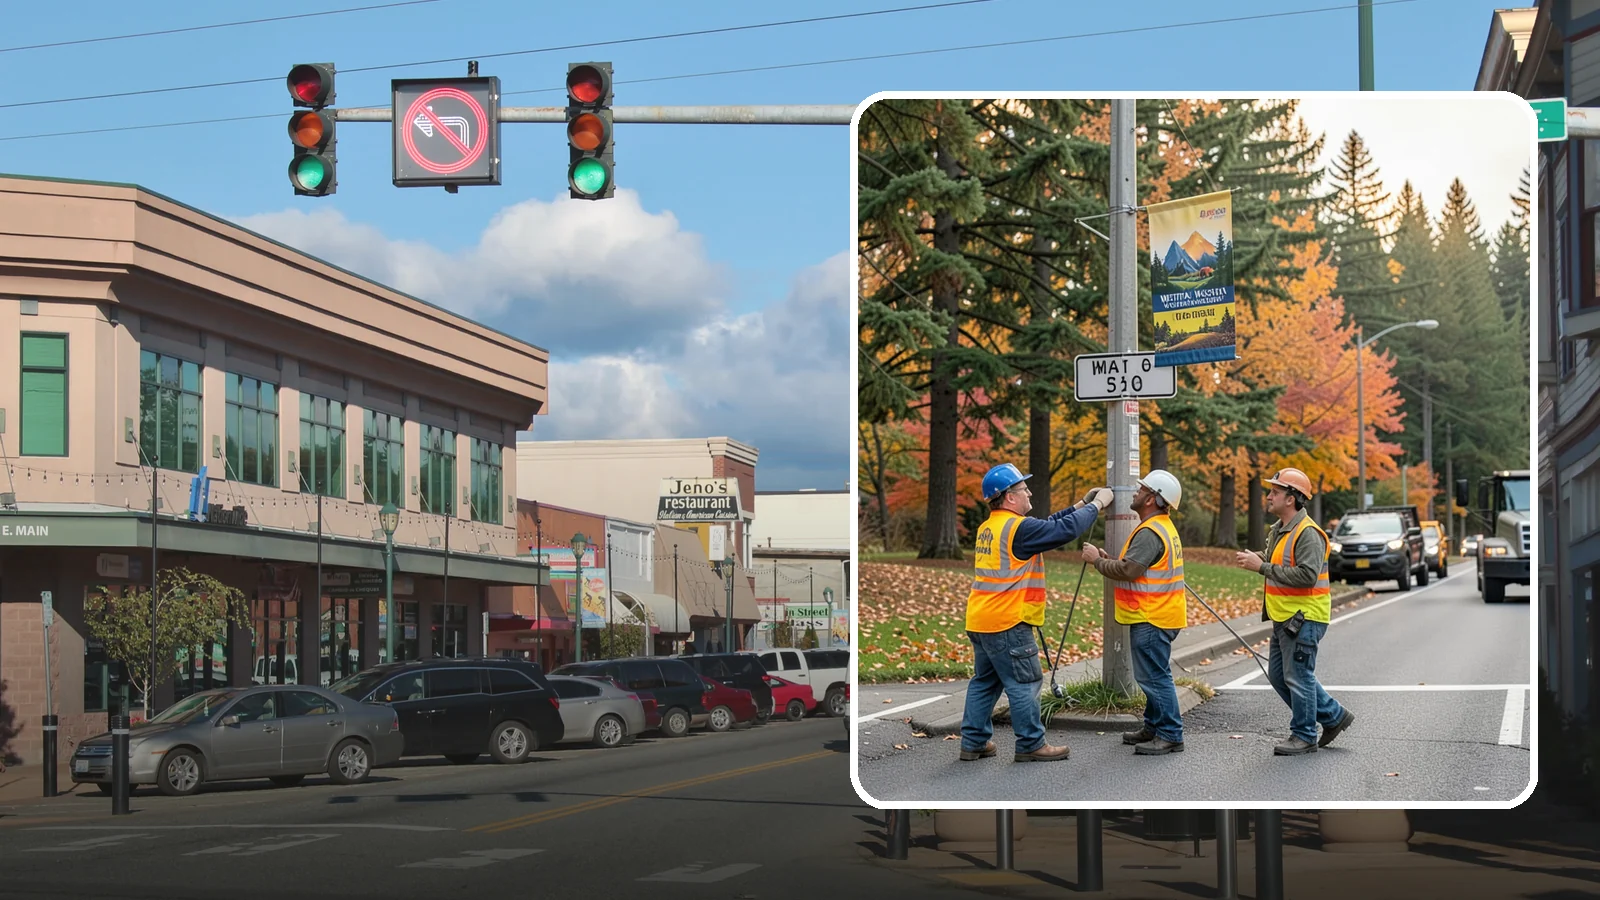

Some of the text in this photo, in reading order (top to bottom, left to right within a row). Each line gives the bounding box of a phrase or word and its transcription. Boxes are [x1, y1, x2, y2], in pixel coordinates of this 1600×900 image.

[670, 480, 727, 494] Jeno's
[665, 496, 731, 509] restaurant
[659, 510, 681, 519] Italian
[686, 510, 714, 519] American
[715, 509, 737, 519] Cuisine
[2, 525, 49, 536] E. MAIN
[797, 607, 828, 616] Street
[791, 619, 824, 627] lass
